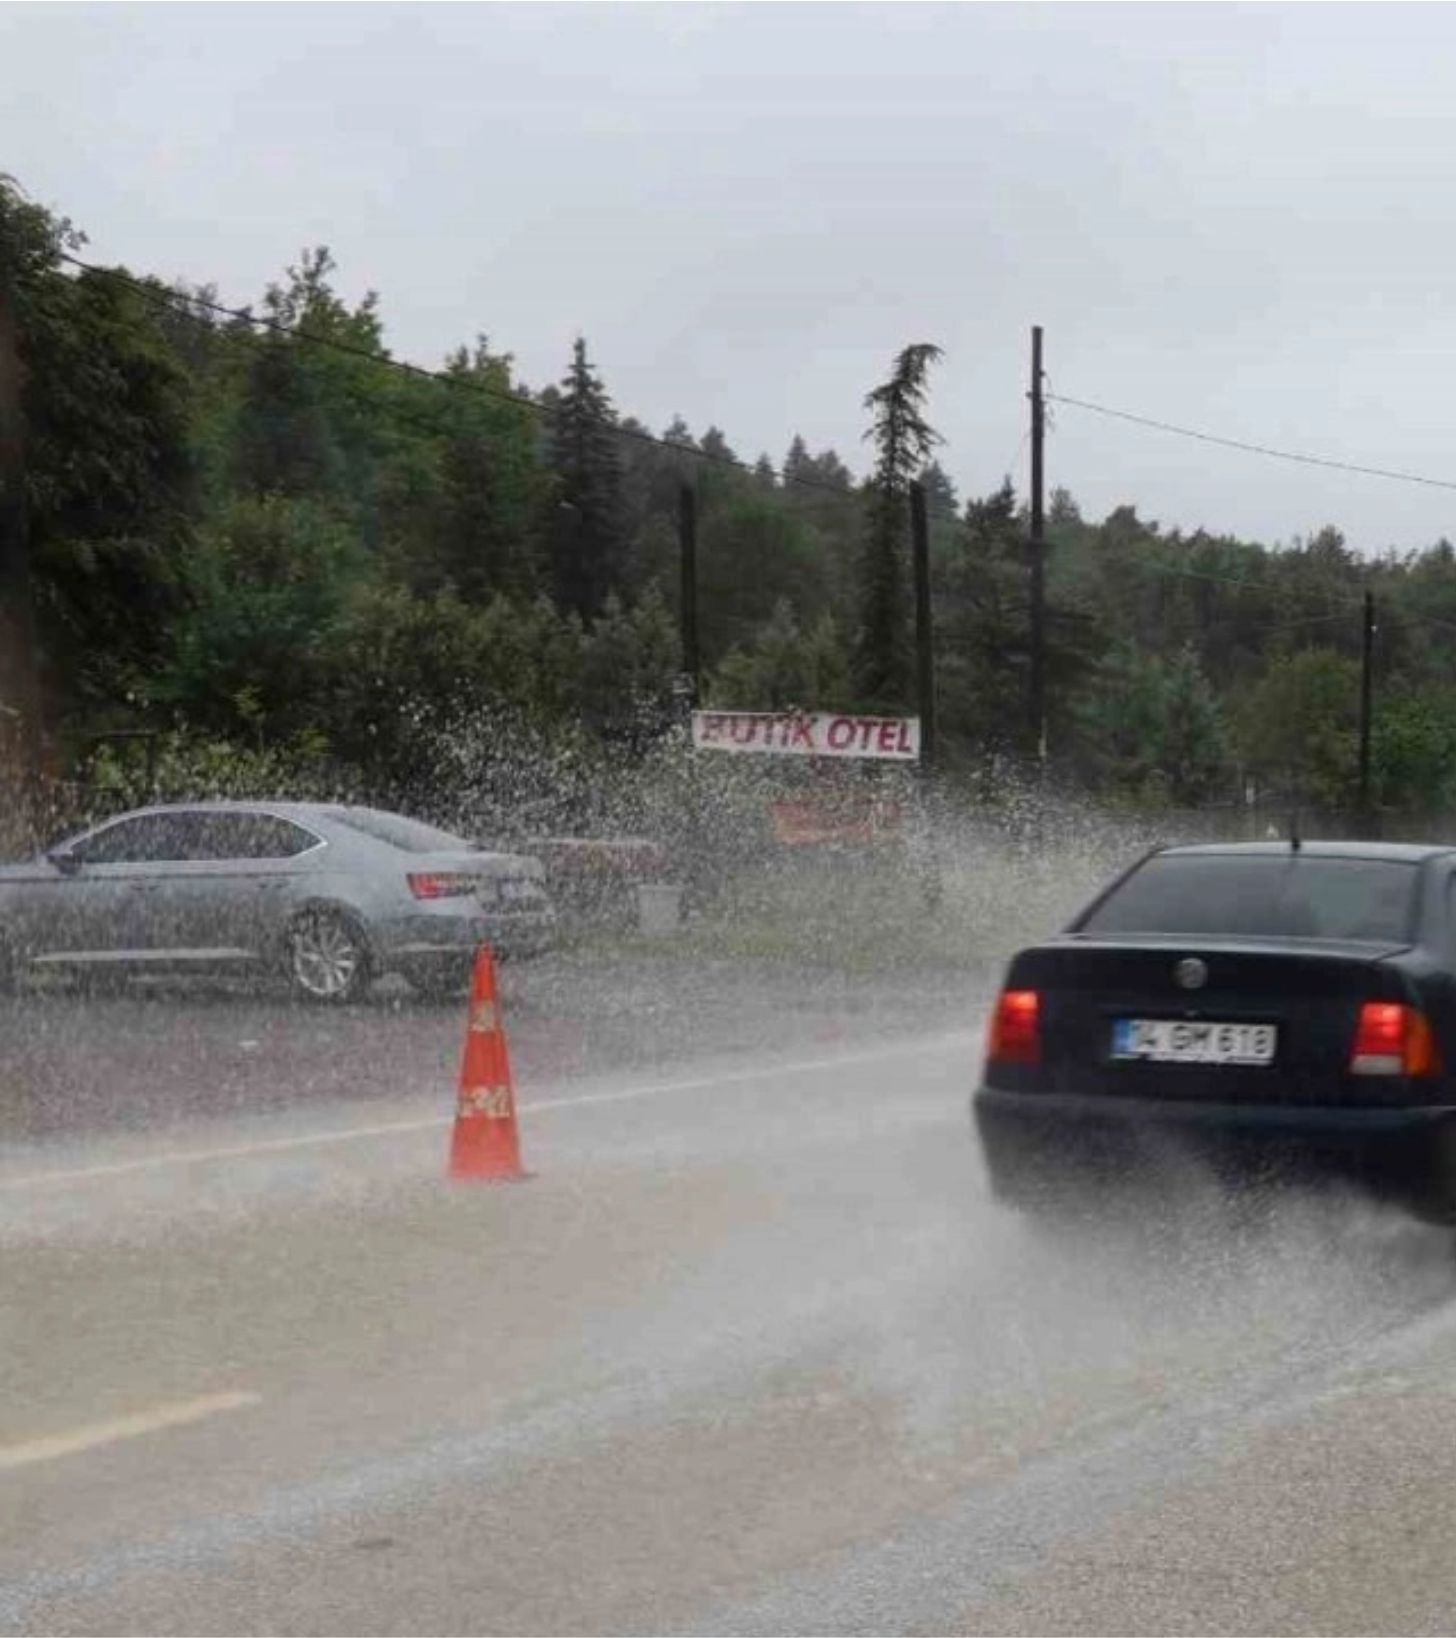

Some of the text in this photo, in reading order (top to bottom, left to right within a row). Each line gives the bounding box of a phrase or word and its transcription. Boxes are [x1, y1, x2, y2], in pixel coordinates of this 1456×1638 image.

[827, 718, 911, 752] OTEL
[1171, 1023, 1212, 1051] GM
[1219, 1027, 1268, 1055] 618
